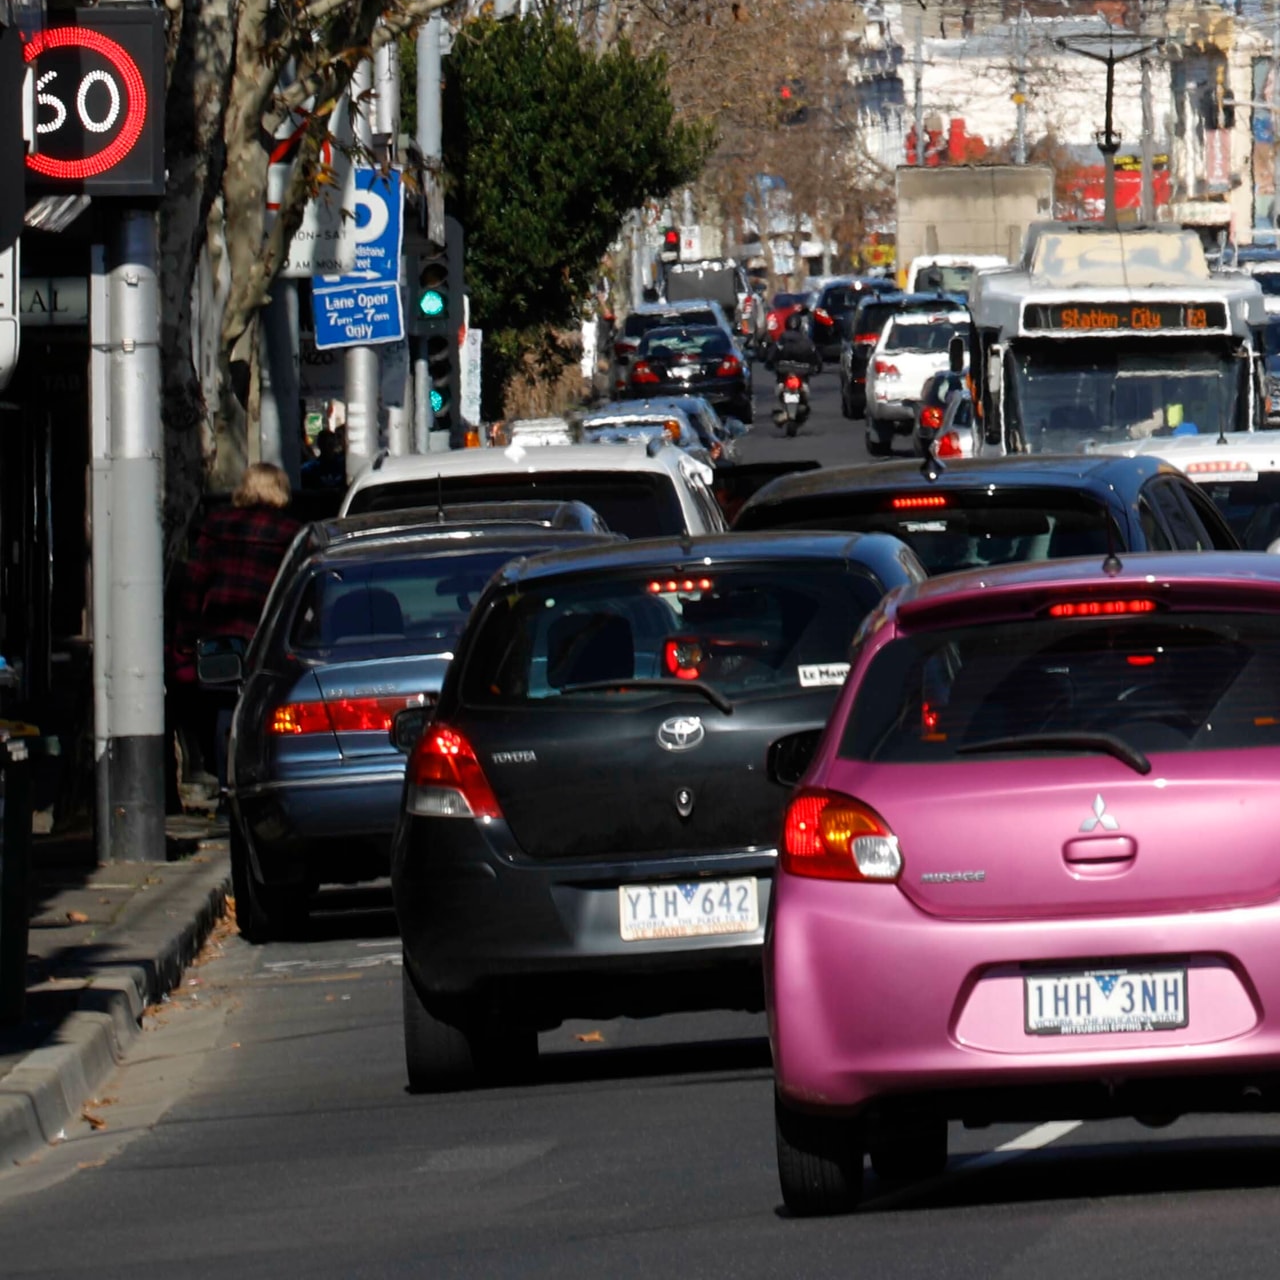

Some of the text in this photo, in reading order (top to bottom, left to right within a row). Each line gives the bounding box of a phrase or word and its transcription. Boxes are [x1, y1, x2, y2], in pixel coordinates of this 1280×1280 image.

[325, 292, 388, 311] Lane Open
[1061, 308, 1118, 329] Station
[1130, 307, 1161, 329] City
[345, 322, 374, 338] Only
[491, 750, 538, 765] TOYOTA
[921, 870, 986, 883] MIRAGE
[627, 885, 750, 920] YIH 642
[1036, 977, 1179, 1018] 1HH 3NH
[1061, 1022, 1141, 1035] MITSUBISHI EPPING
